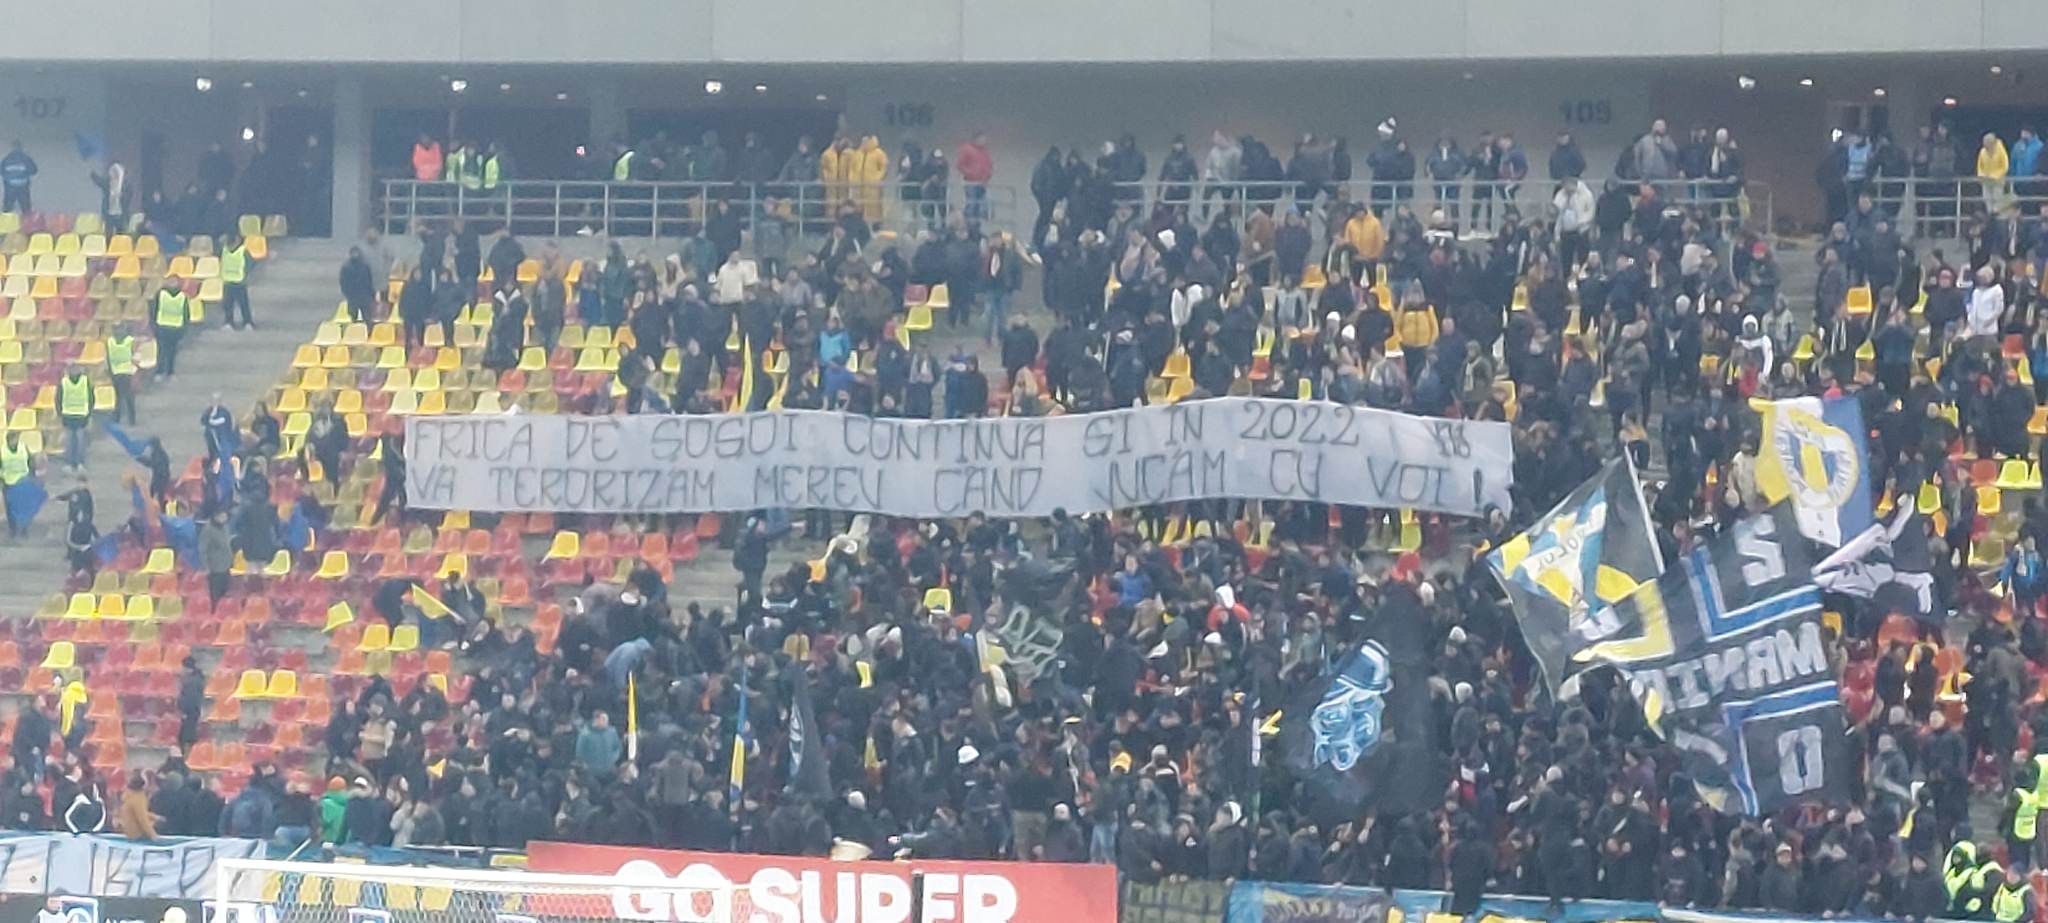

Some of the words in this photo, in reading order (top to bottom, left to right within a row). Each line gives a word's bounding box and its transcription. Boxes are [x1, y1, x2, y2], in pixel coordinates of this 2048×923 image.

[13, 97, 66, 120] 107
[413, 420, 532, 462] FRICA
[566, 418, 620, 461] DE
[1240, 400, 1358, 446] 2022
[1270, 449, 1323, 498] CU
[613, 859, 728, 923] GO
[750, 867, 1018, 923] SUPER
